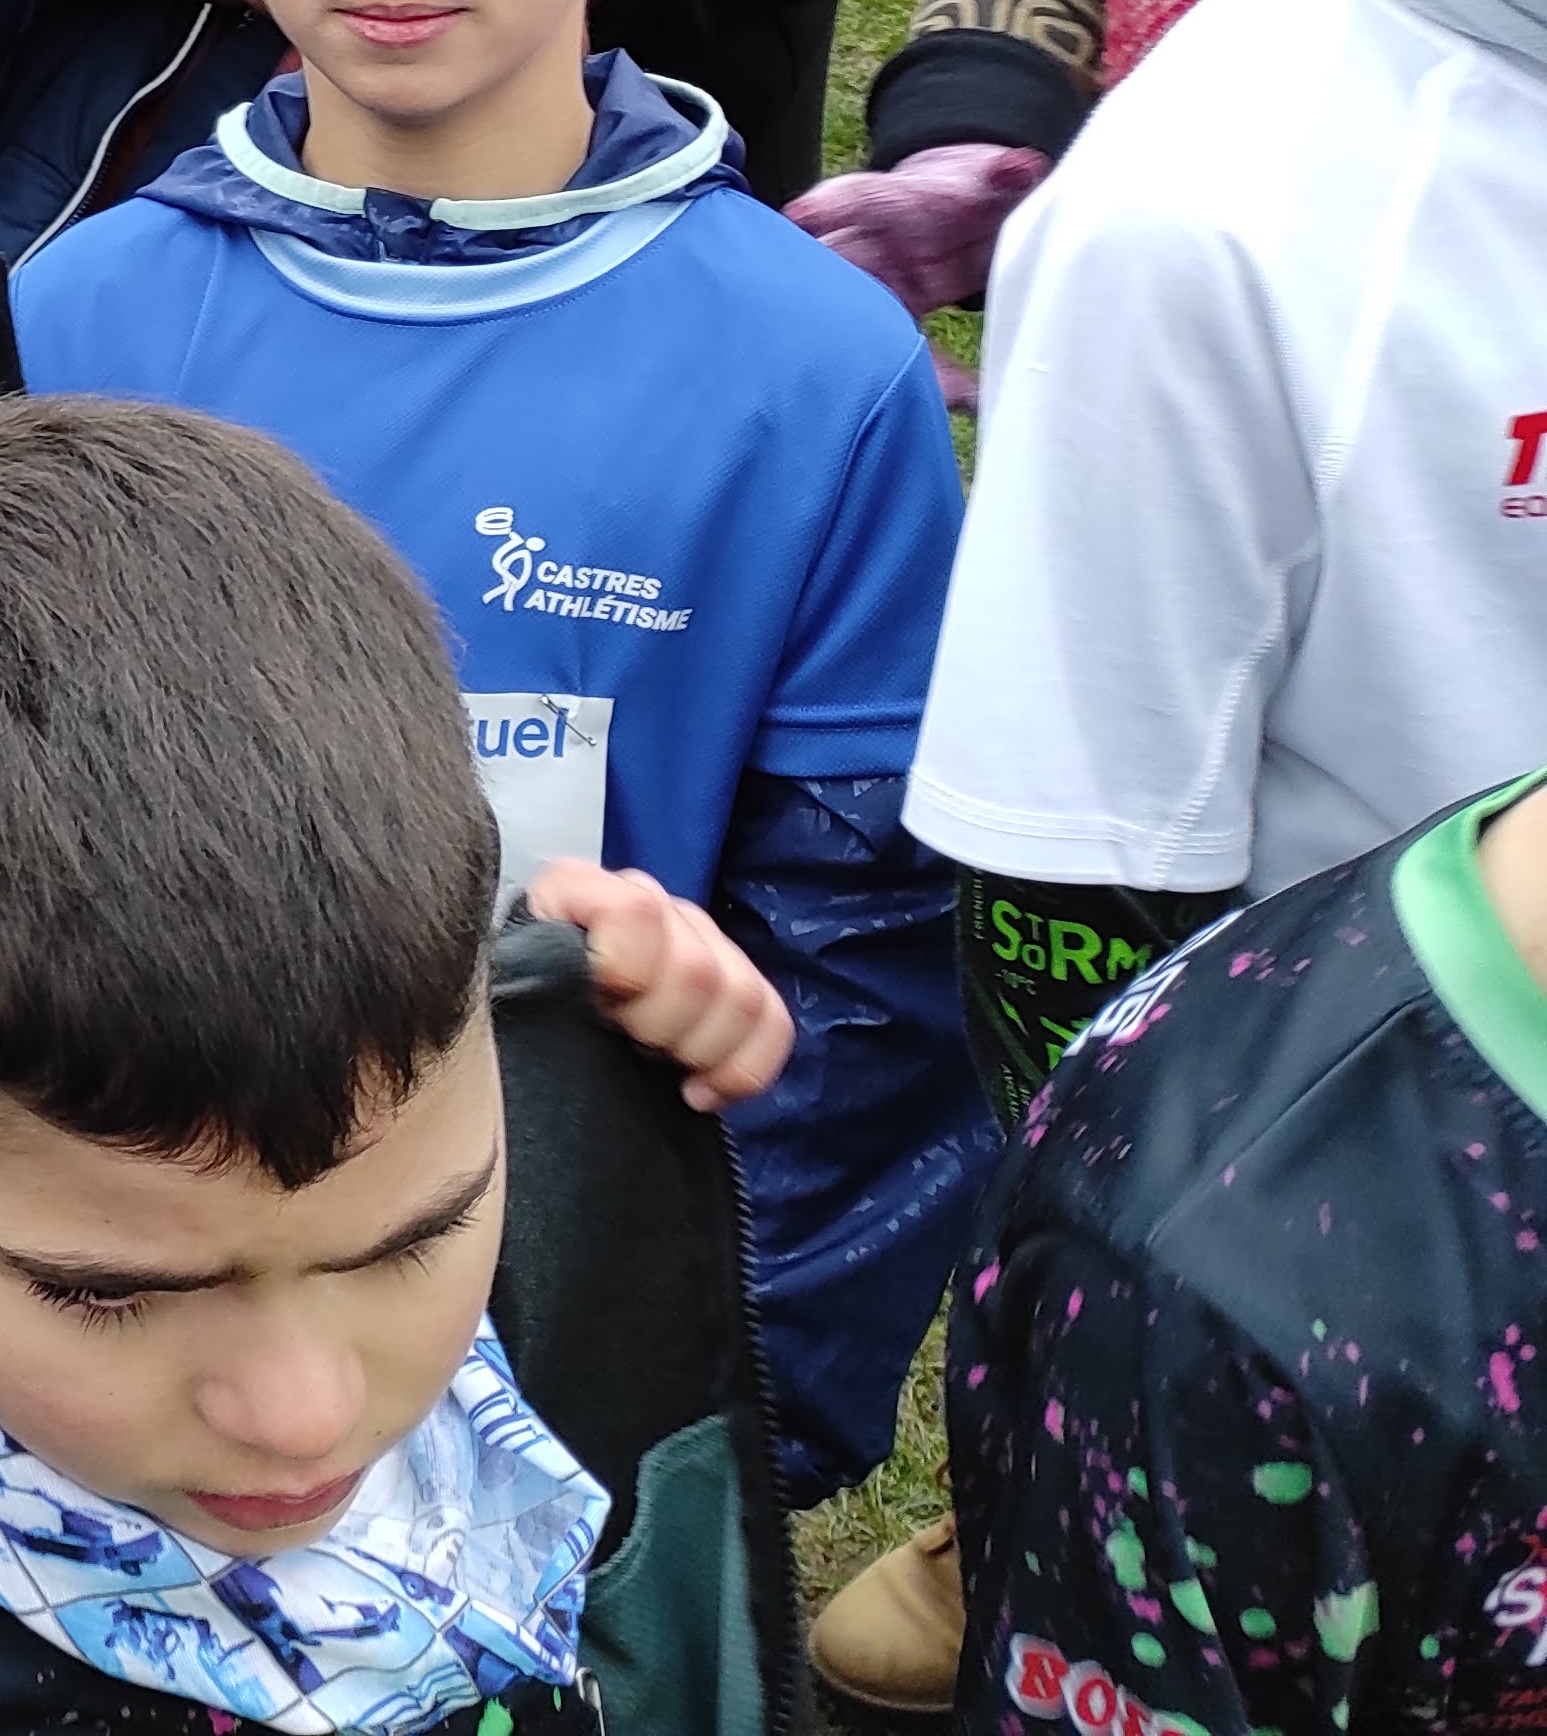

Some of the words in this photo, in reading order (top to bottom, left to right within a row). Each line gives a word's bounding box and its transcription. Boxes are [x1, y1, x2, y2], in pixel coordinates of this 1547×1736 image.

[537, 560, 662, 601] CASTRES
[524, 588, 694, 632] ATHLÉTISME
[474, 708, 570, 759] uel
